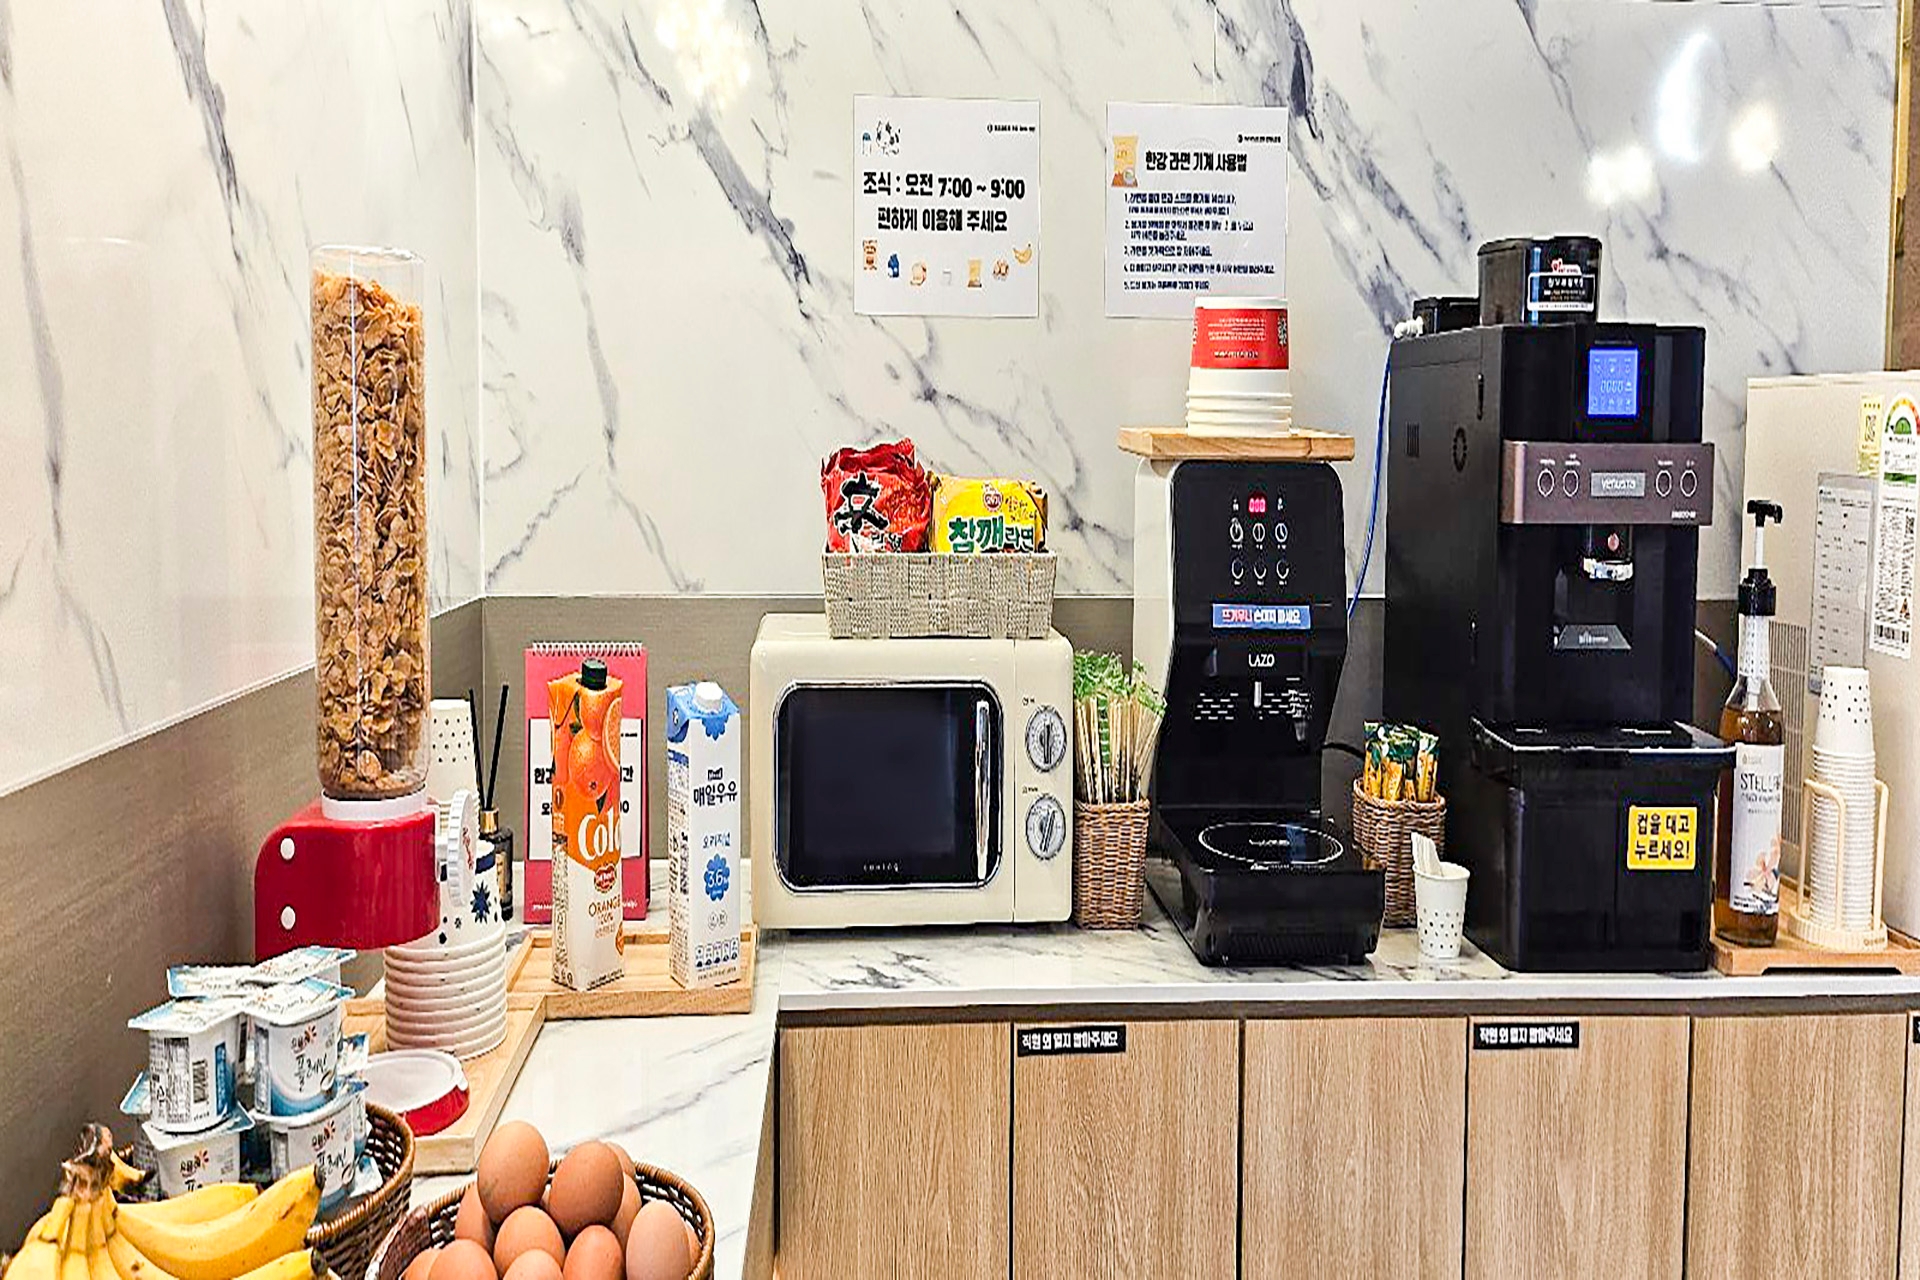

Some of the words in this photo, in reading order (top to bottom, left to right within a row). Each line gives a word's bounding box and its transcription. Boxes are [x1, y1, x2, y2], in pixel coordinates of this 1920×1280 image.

[1146, 150, 1168, 170] 한강
[1170, 152, 1190, 170] 라면
[1193, 152, 1213, 171] 기계
[1215, 153, 1247, 172] 사용법
[864, 172, 891, 196] 조식
[906, 174, 933, 196] 오전
[938, 177, 972, 198] 7:00
[991, 178, 1025, 199] 9:00
[878, 207, 917, 231] 편하게
[922, 208, 963, 232] 이용해
[967, 209, 1007, 232] 주세요
[949, 515, 1034, 553] 참깨라면
[1248, 653, 1275, 667] LAZO
[694, 781, 737, 807] 매일우유
[1637, 813, 1661, 835] 컵을
[1666, 815, 1689, 835] 대고
[1635, 840, 1690, 860] 누르세요!
[589, 894, 621, 917] ORANGE
[1022, 1033, 1041, 1050] 직원
[1042, 1032, 1051, 1049] 외
[1053, 1032, 1071, 1049] 열지
[1073, 1031, 1118, 1048] 말아주세요
